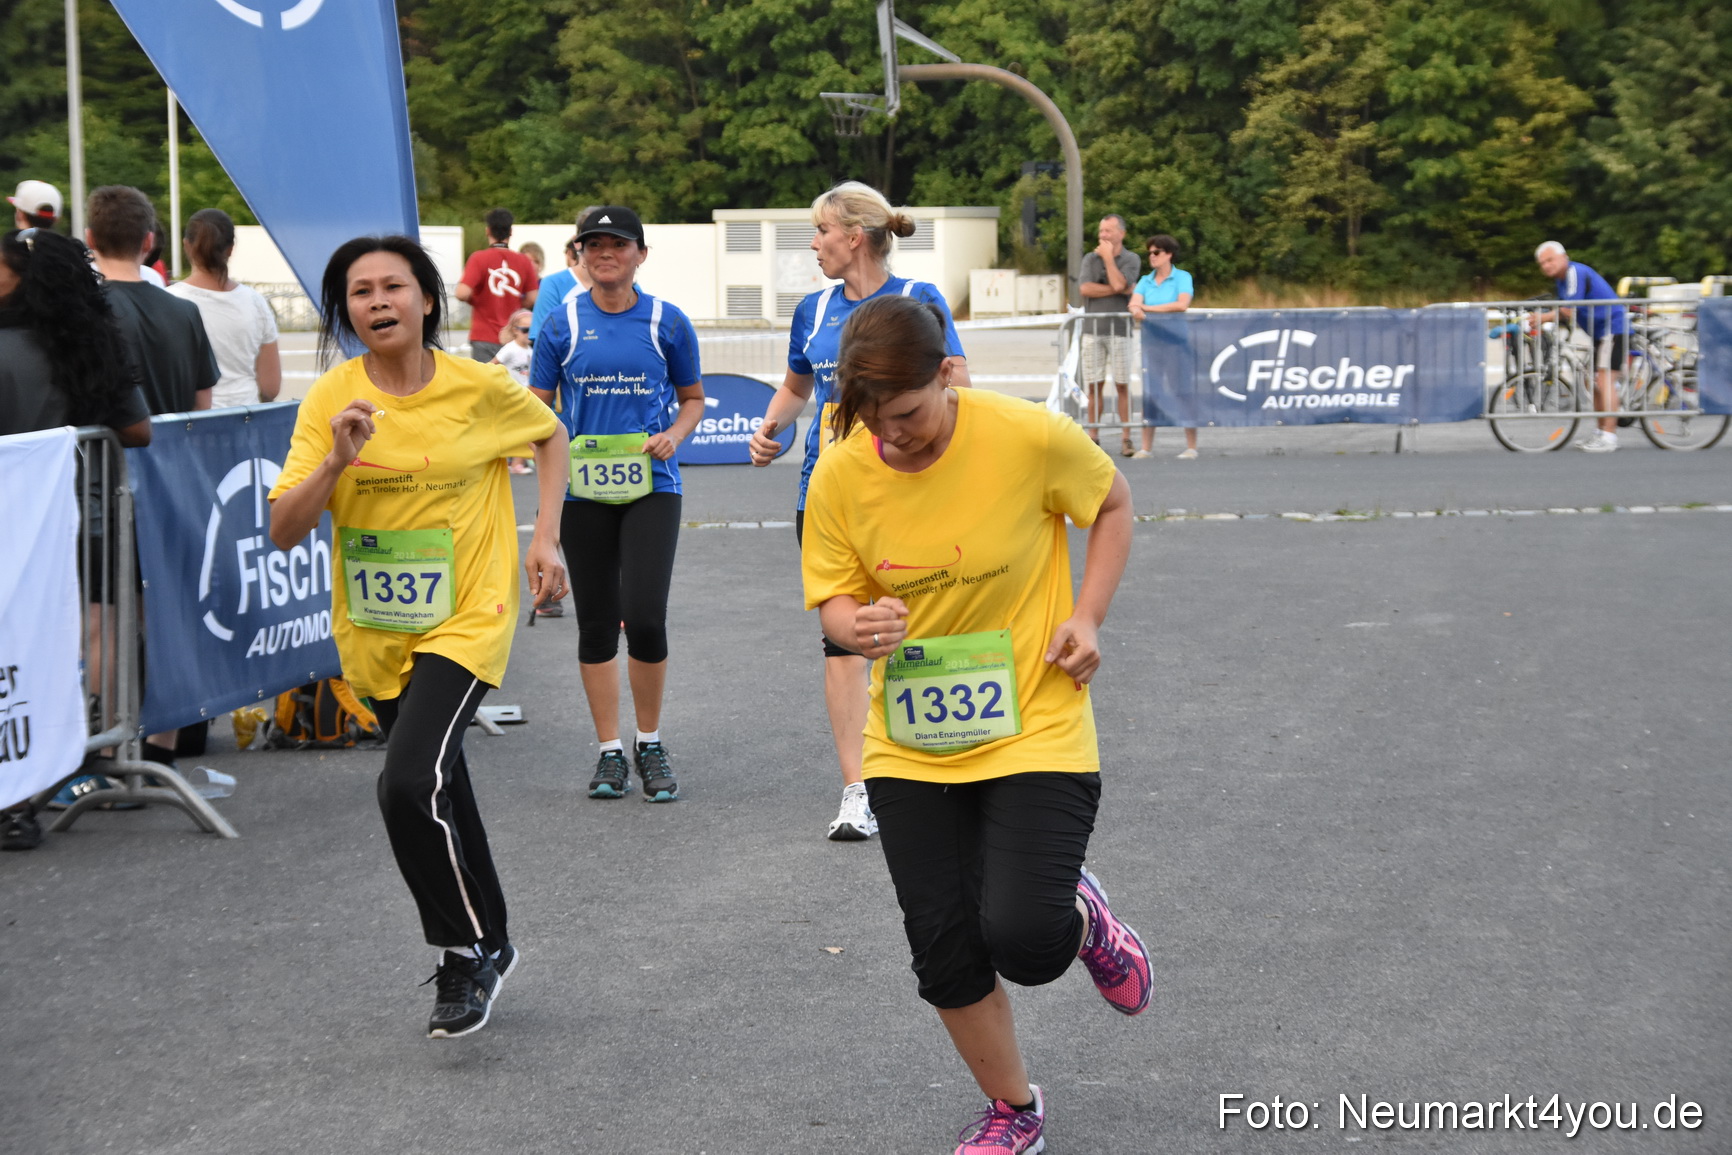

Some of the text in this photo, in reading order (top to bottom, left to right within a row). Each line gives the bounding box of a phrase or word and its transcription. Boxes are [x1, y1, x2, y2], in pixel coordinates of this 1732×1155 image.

[1246, 357, 1415, 392] Fischer
[585, 385, 609, 397] jeder
[610, 386, 631, 395] nach
[1261, 393, 1401, 410] AUTOMOBILE
[694, 412, 764, 434] ische
[691, 433, 754, 445] AUTOMOB
[355, 474, 413, 486] Seniorenstift
[578, 462, 643, 486] 1358
[372, 485, 400, 493] Tiroler
[402, 484, 419, 493] Hof
[425, 479, 467, 491] Neumarkt
[393, 551, 415, 559] 2015
[236, 528, 332, 615] Fisch
[892, 569, 949, 592] Seniorenstift
[910, 585, 938, 598] Tiroler
[940, 577, 957, 590] Hof
[961, 564, 1009, 586] Neumarkt
[354, 569, 442, 605] 1337
[363, 607, 434, 619] Kwanwan Wiangkham
[245, 609, 333, 659] AUTOMO
[897, 656, 970, 669] firmenlauf 2015
[896, 681, 1005, 724] 1332
[915, 728, 991, 740] Diana Enzingmüller
